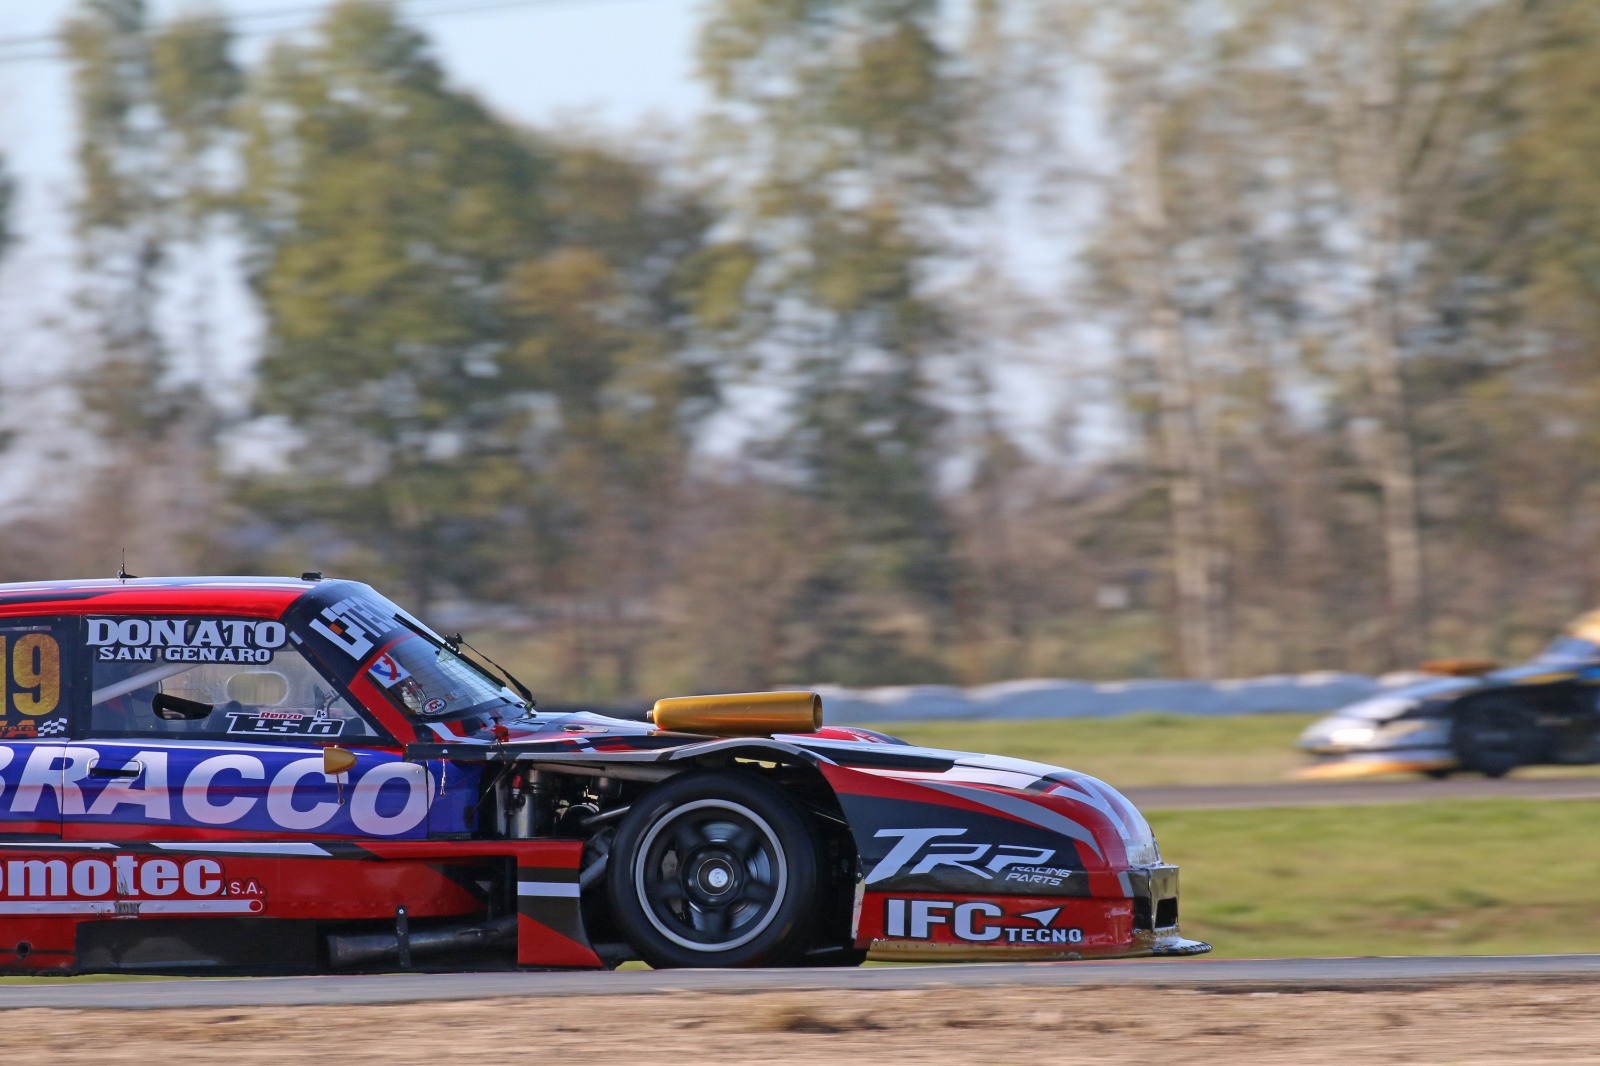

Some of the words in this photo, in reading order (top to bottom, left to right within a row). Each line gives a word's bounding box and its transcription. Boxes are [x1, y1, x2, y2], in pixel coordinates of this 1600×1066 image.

[86, 619, 286, 648] DONATO
[0, 633, 60, 716] 9
[99, 647, 152, 661] SAN
[165, 647, 271, 662] GENARO
[0, 745, 433, 836] RACCO
[0, 855, 222, 896] motec
[230, 881, 263, 895] S.A.
[865, 827, 1057, 885] TRP
[1011, 865, 1073, 878] RACING
[1005, 872, 1063, 886] PARTS
[887, 899, 1003, 941] IFC
[1004, 928, 1082, 943] TECNO
